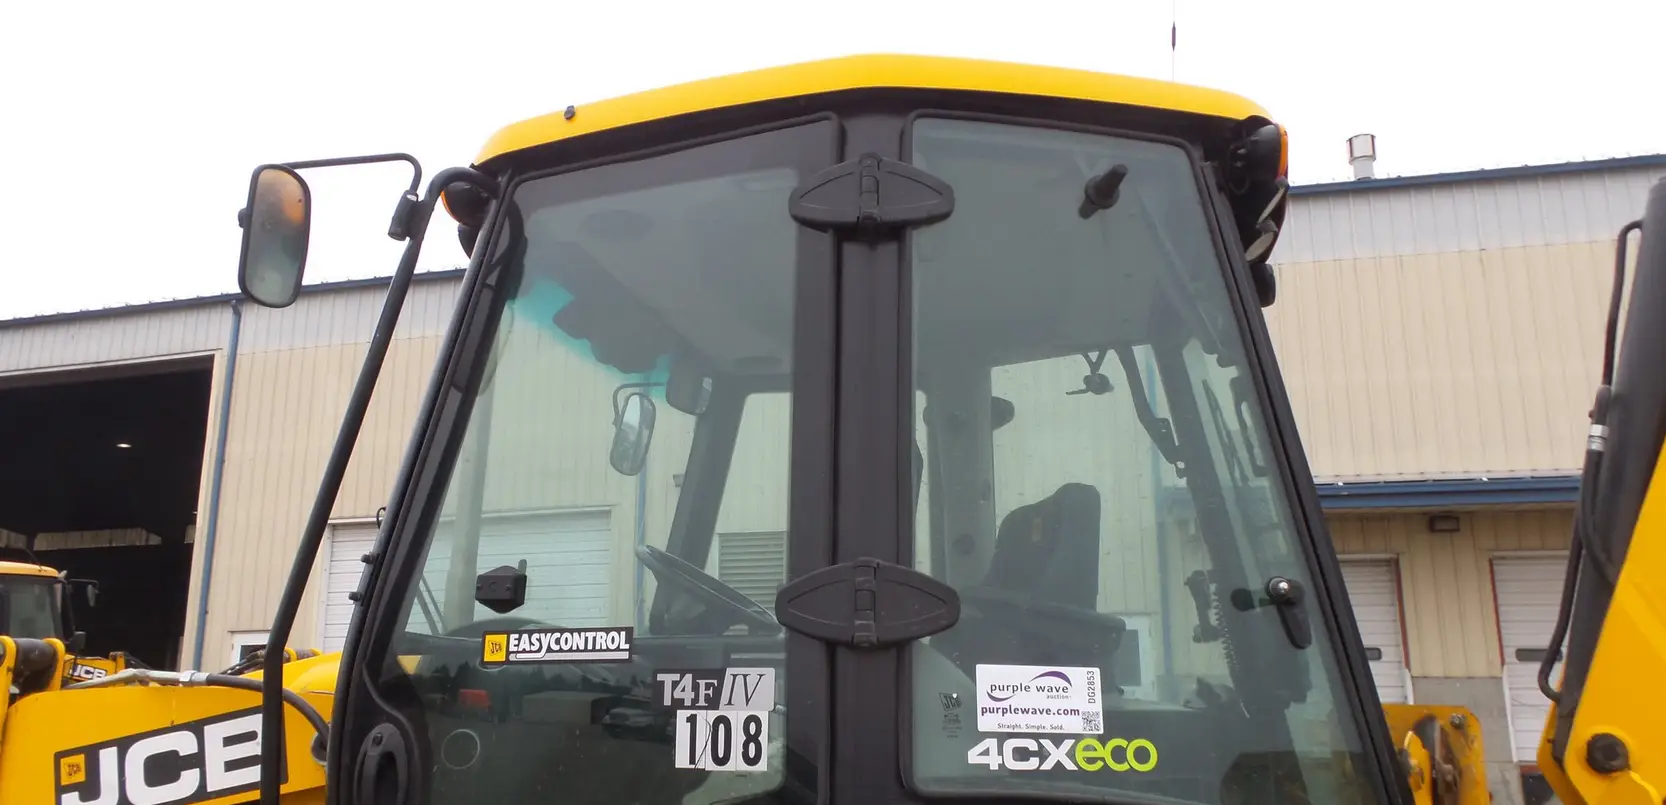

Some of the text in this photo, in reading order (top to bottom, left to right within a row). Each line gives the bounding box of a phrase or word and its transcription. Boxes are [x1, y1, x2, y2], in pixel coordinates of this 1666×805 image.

[509, 631, 630, 658] EASYCONTROL
[69, 664, 107, 680] JCB
[723, 673, 766, 707] IV
[990, 682, 1069, 694] purple wave
[1086, 670, 1096, 704] DG2853
[981, 704, 1080, 717] purplewave.com
[685, 713, 763, 767] 108
[997, 722, 1022, 731] Straight.
[1025, 723, 1048, 731] Simple.
[60, 713, 263, 805] JCB
